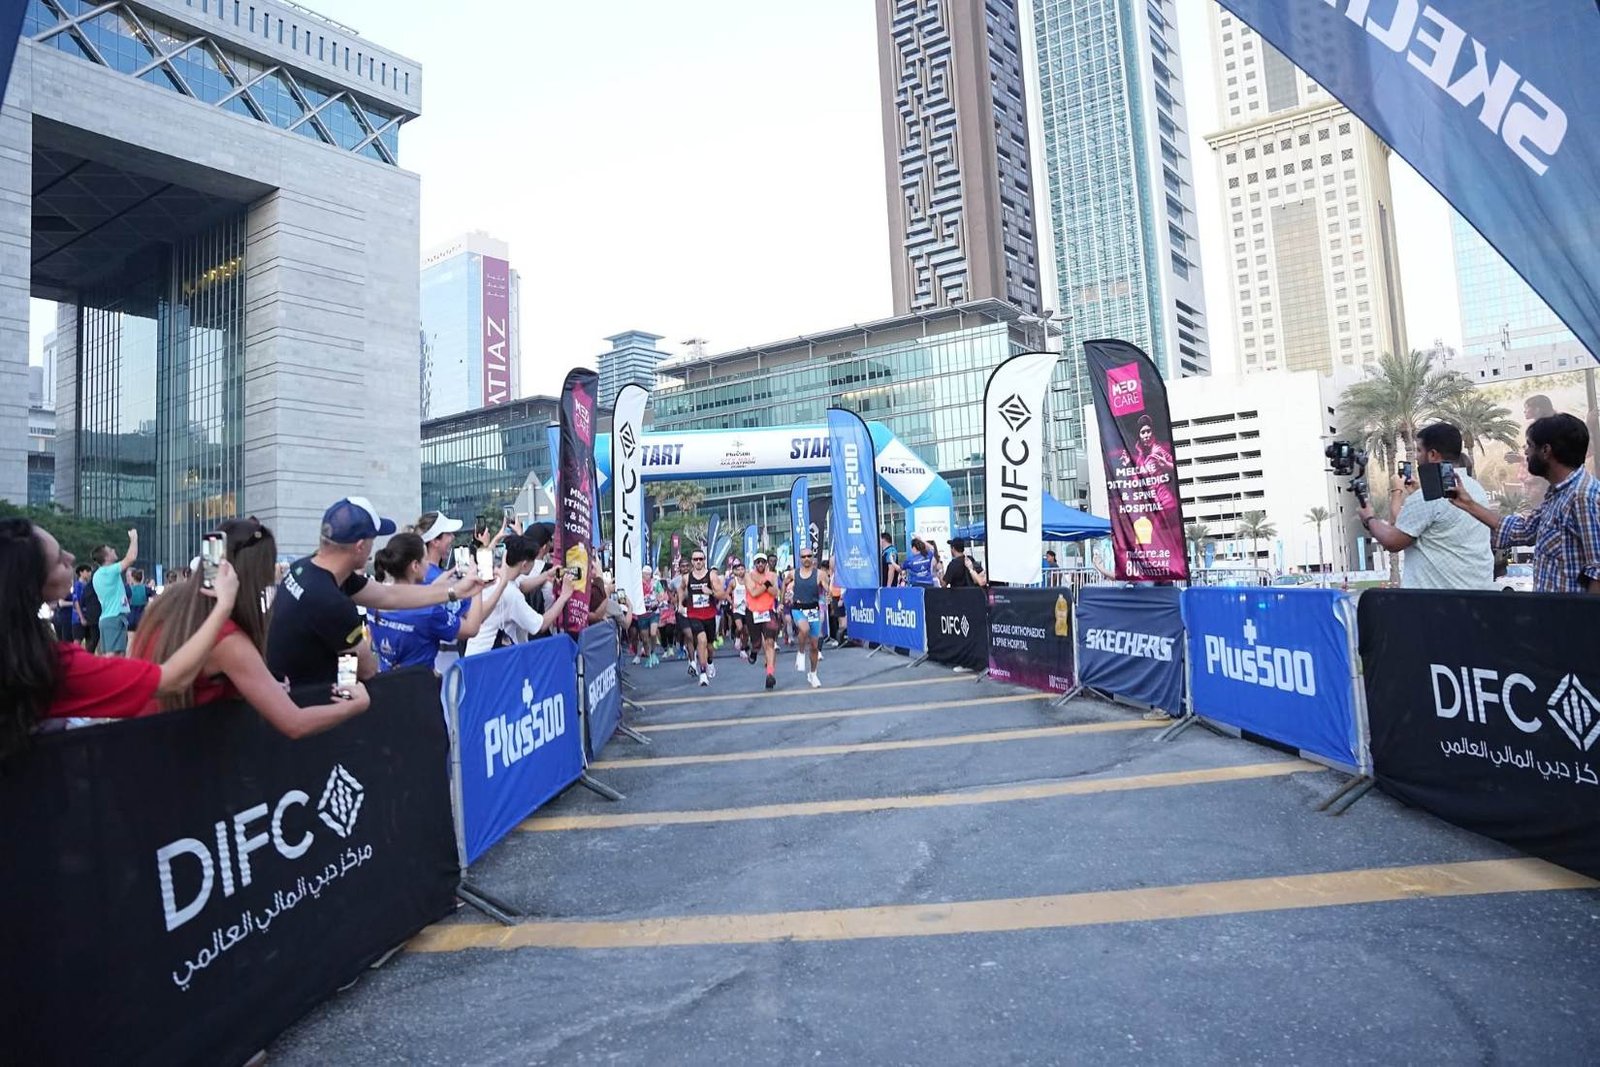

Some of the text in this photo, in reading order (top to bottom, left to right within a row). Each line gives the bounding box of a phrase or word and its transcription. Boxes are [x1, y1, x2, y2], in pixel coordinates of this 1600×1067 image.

[1112, 380, 1137, 397] MED
[1113, 392, 1139, 408] CARE
[641, 444, 684, 466] TART
[790, 437, 831, 459] STAR
[880, 466, 925, 475] Plus500
[1000, 436, 1030, 533] DIFC
[1121, 491, 1130, 501] &
[570, 512, 576, 521] &
[621, 462, 638, 562] DIFC
[284, 573, 305, 601] TEAM
[850, 605, 875, 624] Plus500
[885, 607, 916, 629] Plus500
[941, 615, 960, 636] DIFC
[991, 623, 1011, 635] MEDCARE
[1085, 628, 1175, 662] SKECHERS
[1204, 633, 1316, 697] Plus500
[1430, 663, 1543, 734] DIFC
[483, 692, 565, 778] Plus500
[1440, 737, 1598, 785] كز دبي المالي العالمي
[156, 789, 315, 933] DIFC
[172, 844, 373, 992] مركز دبي المالي العالمي
